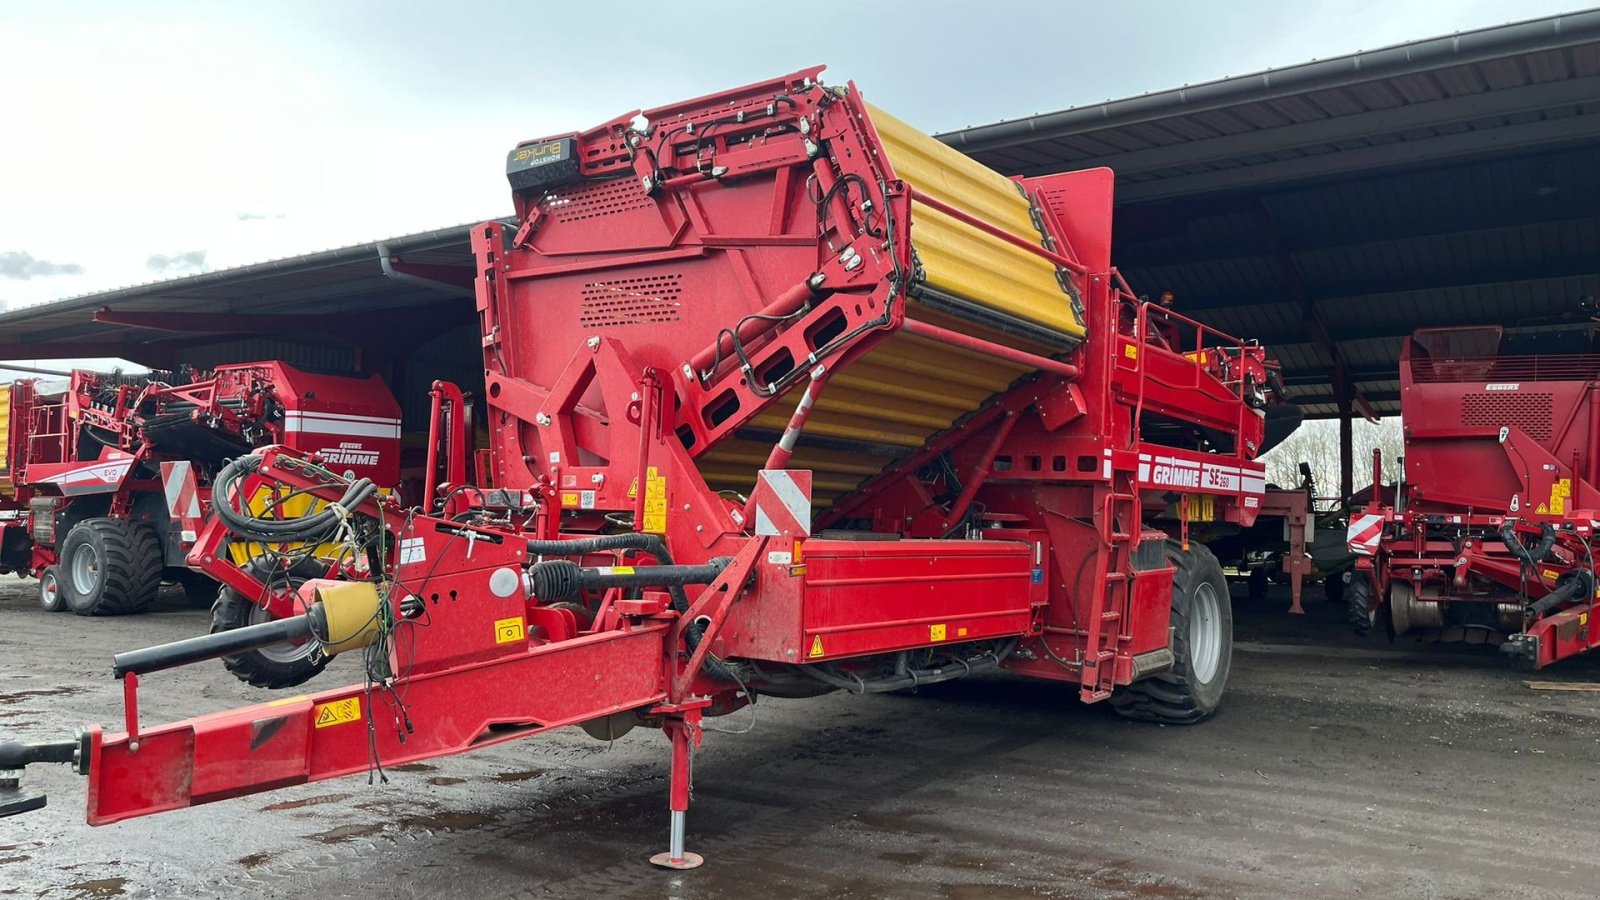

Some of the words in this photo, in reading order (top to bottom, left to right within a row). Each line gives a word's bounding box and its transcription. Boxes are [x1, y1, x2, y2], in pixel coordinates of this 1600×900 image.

[513, 142, 560, 163] Bunker
[530, 154, 560, 166] NONSTOP
[320, 452, 379, 466] GRIMME
[104, 469, 117, 477] EVO
[344, 472, 354, 480] 40
[1153, 464, 1200, 488] GRIMME
[1208, 468, 1220, 486] SE
[1219, 476, 1230, 488] 260
